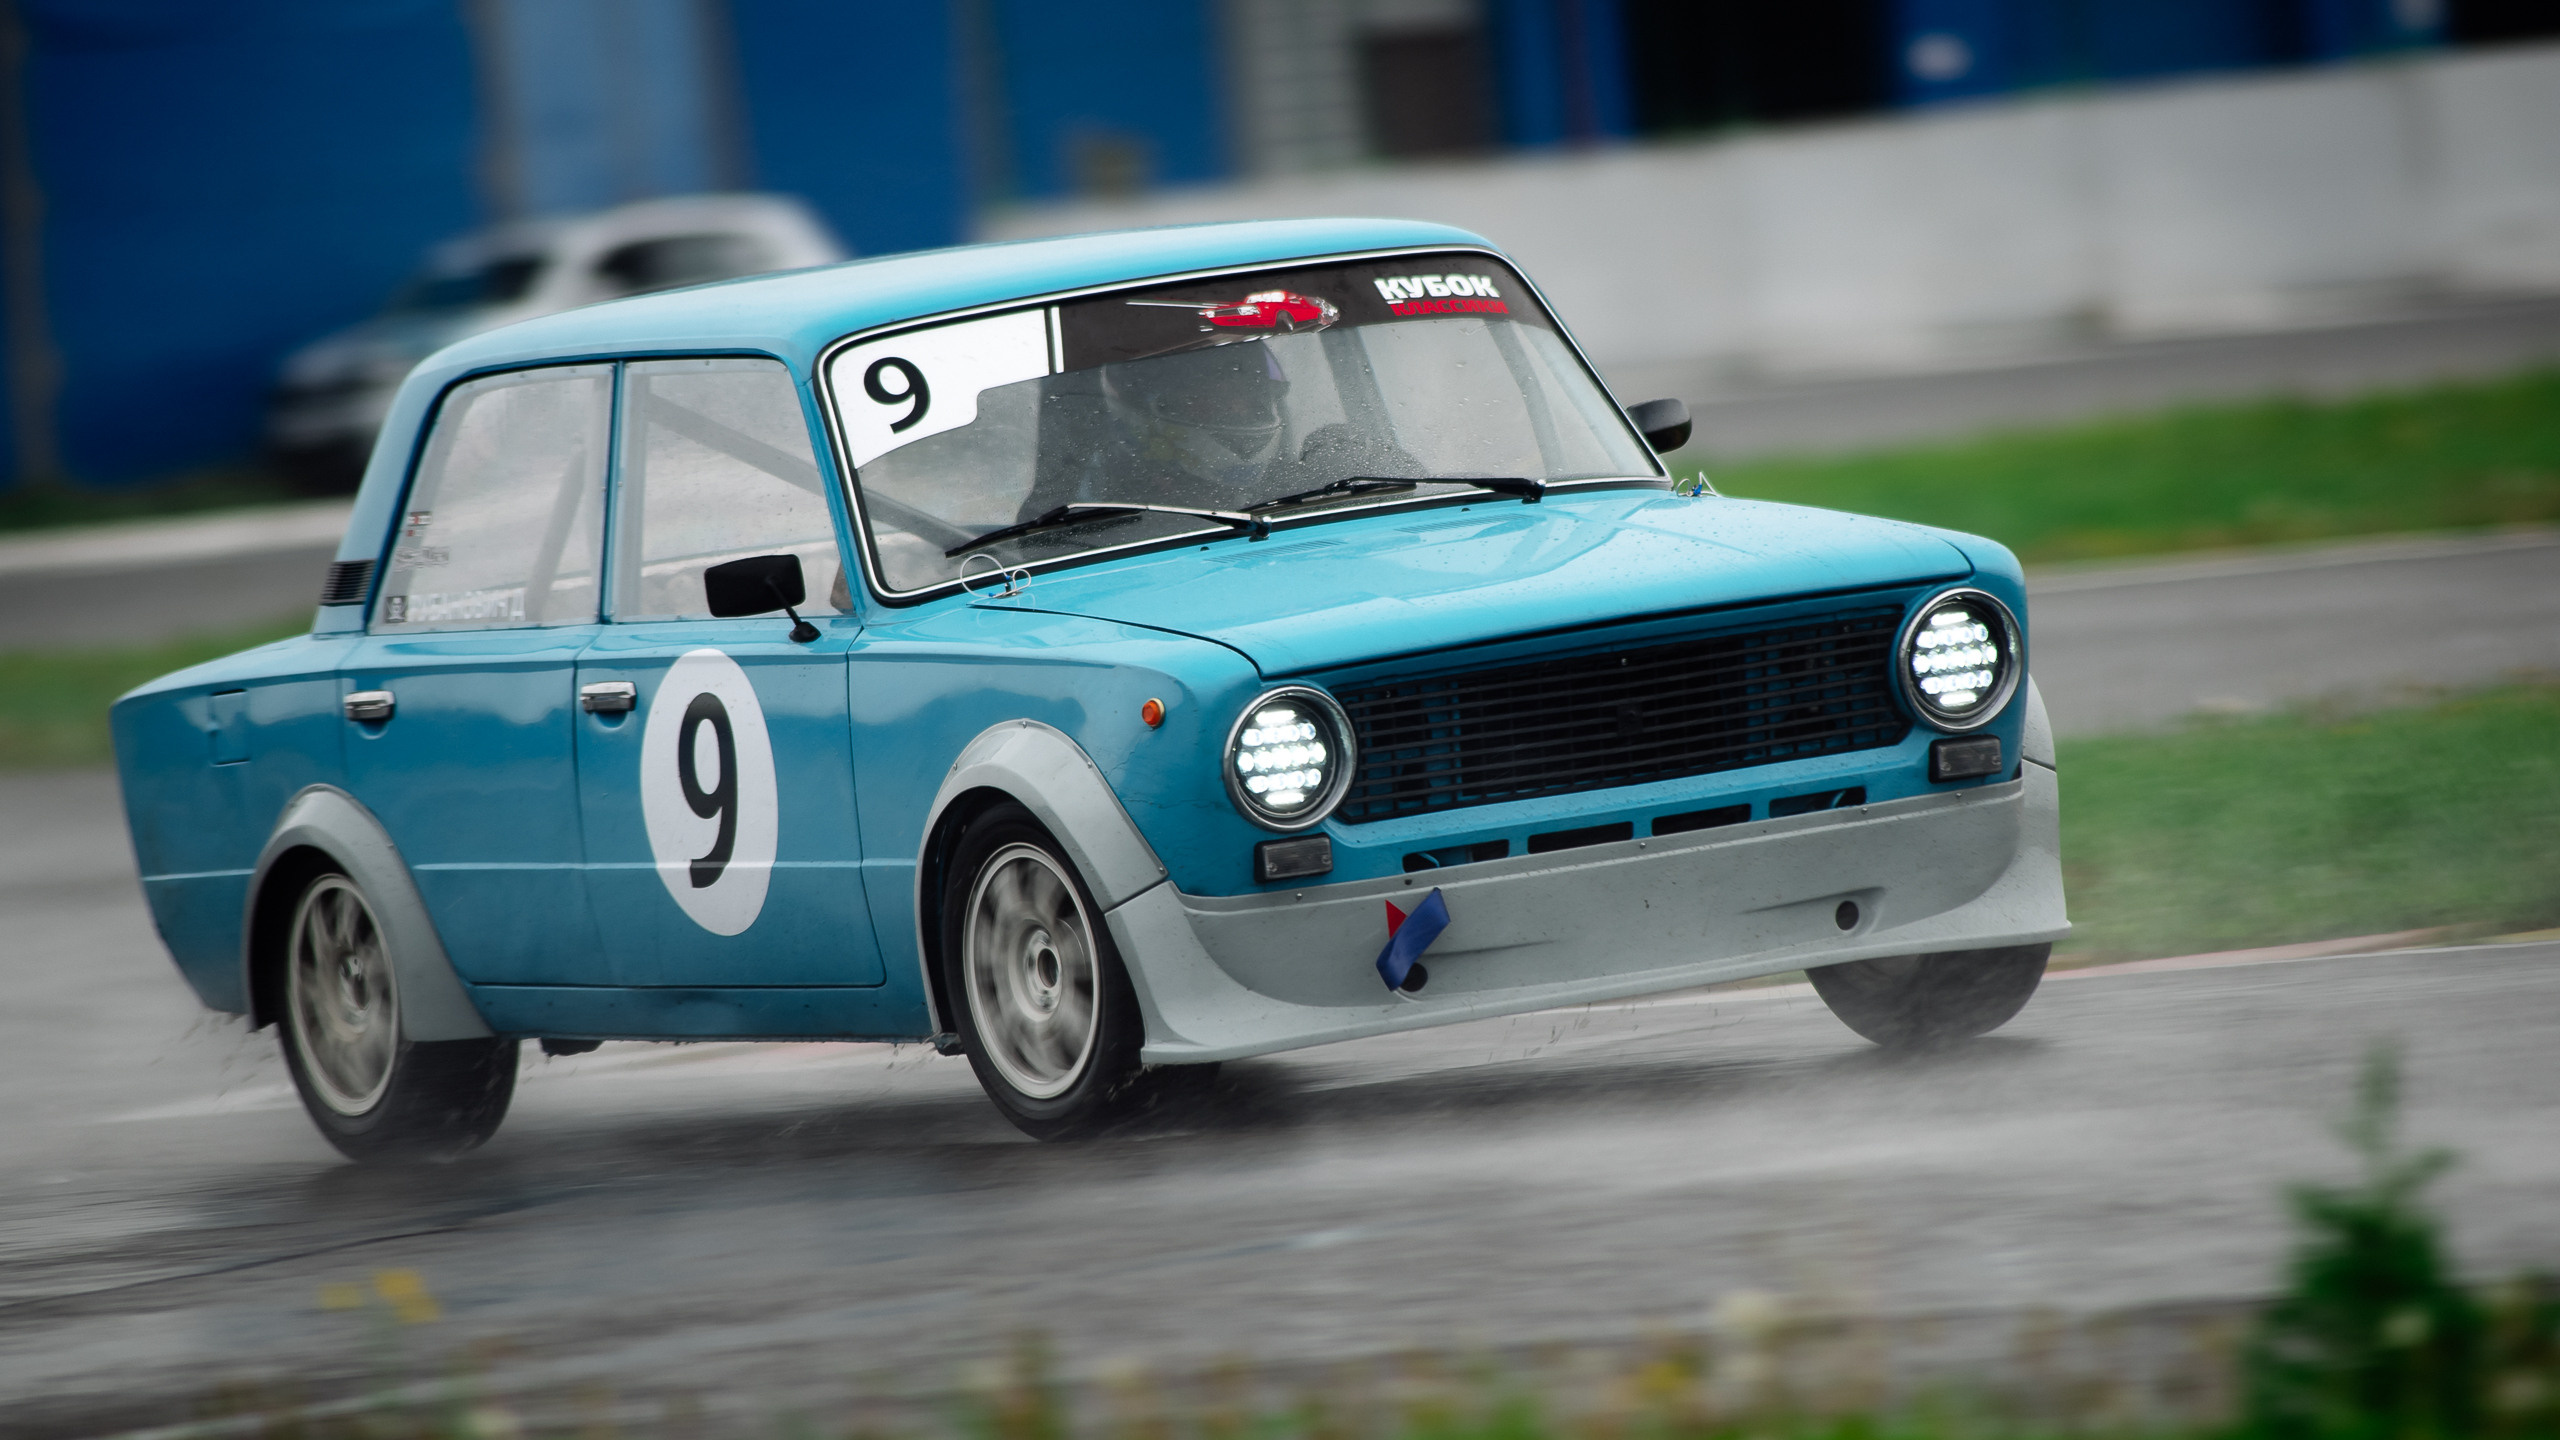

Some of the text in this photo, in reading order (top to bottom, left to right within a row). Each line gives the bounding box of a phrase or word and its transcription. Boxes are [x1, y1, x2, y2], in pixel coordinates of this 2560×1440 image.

[1374, 274, 1500, 300] КУБОК
[1388, 300, 1509, 316] КЛАССИКИ
[863, 356, 931, 434] 9
[678, 692, 738, 888] 9
